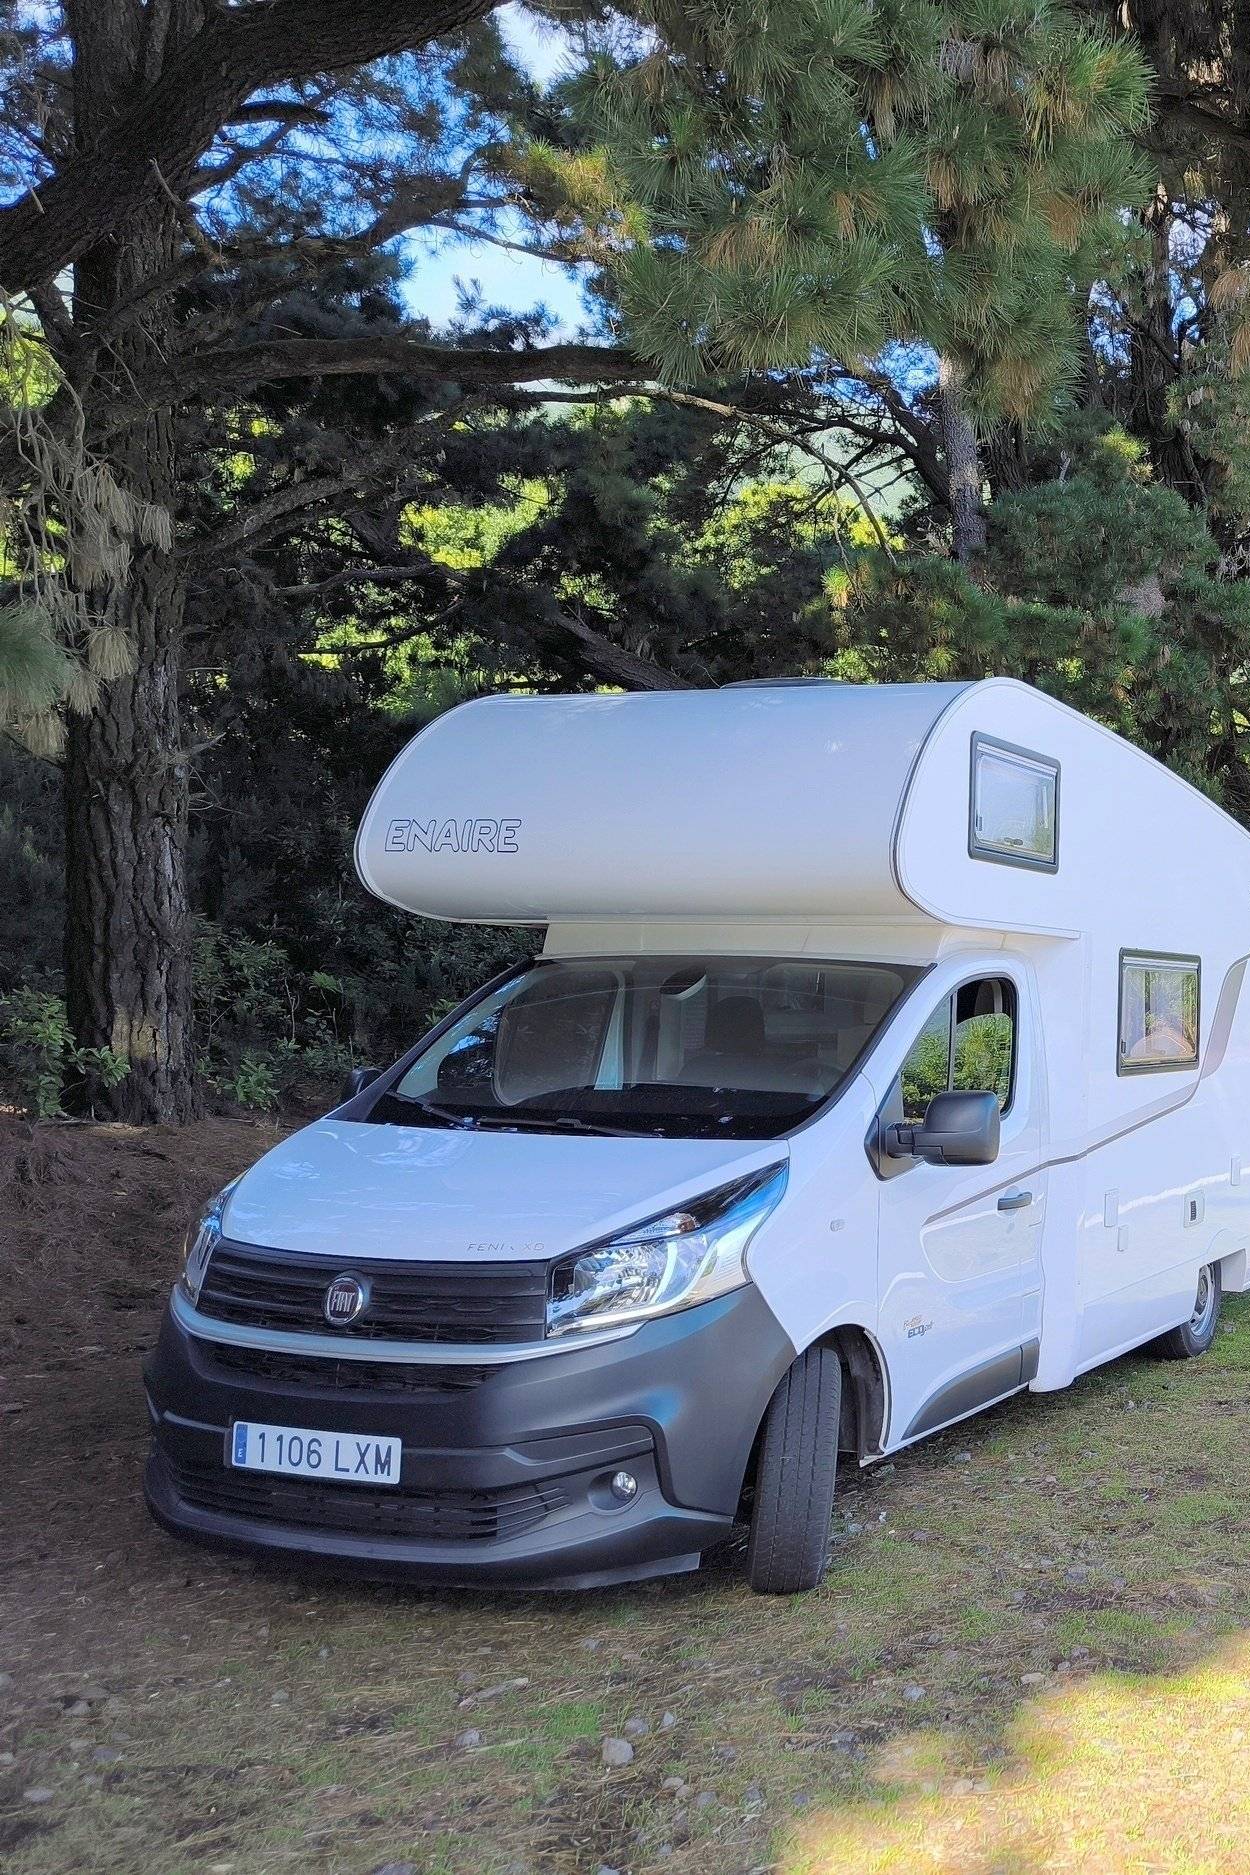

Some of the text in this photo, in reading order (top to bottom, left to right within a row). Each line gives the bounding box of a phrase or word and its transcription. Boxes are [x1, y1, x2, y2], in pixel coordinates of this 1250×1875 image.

[385, 818, 522, 853] ENAIRE
[331, 1290, 355, 1312] FIAT
[238, 1448, 244, 1458] E
[259, 1431, 393, 1477] 1106 LXM
